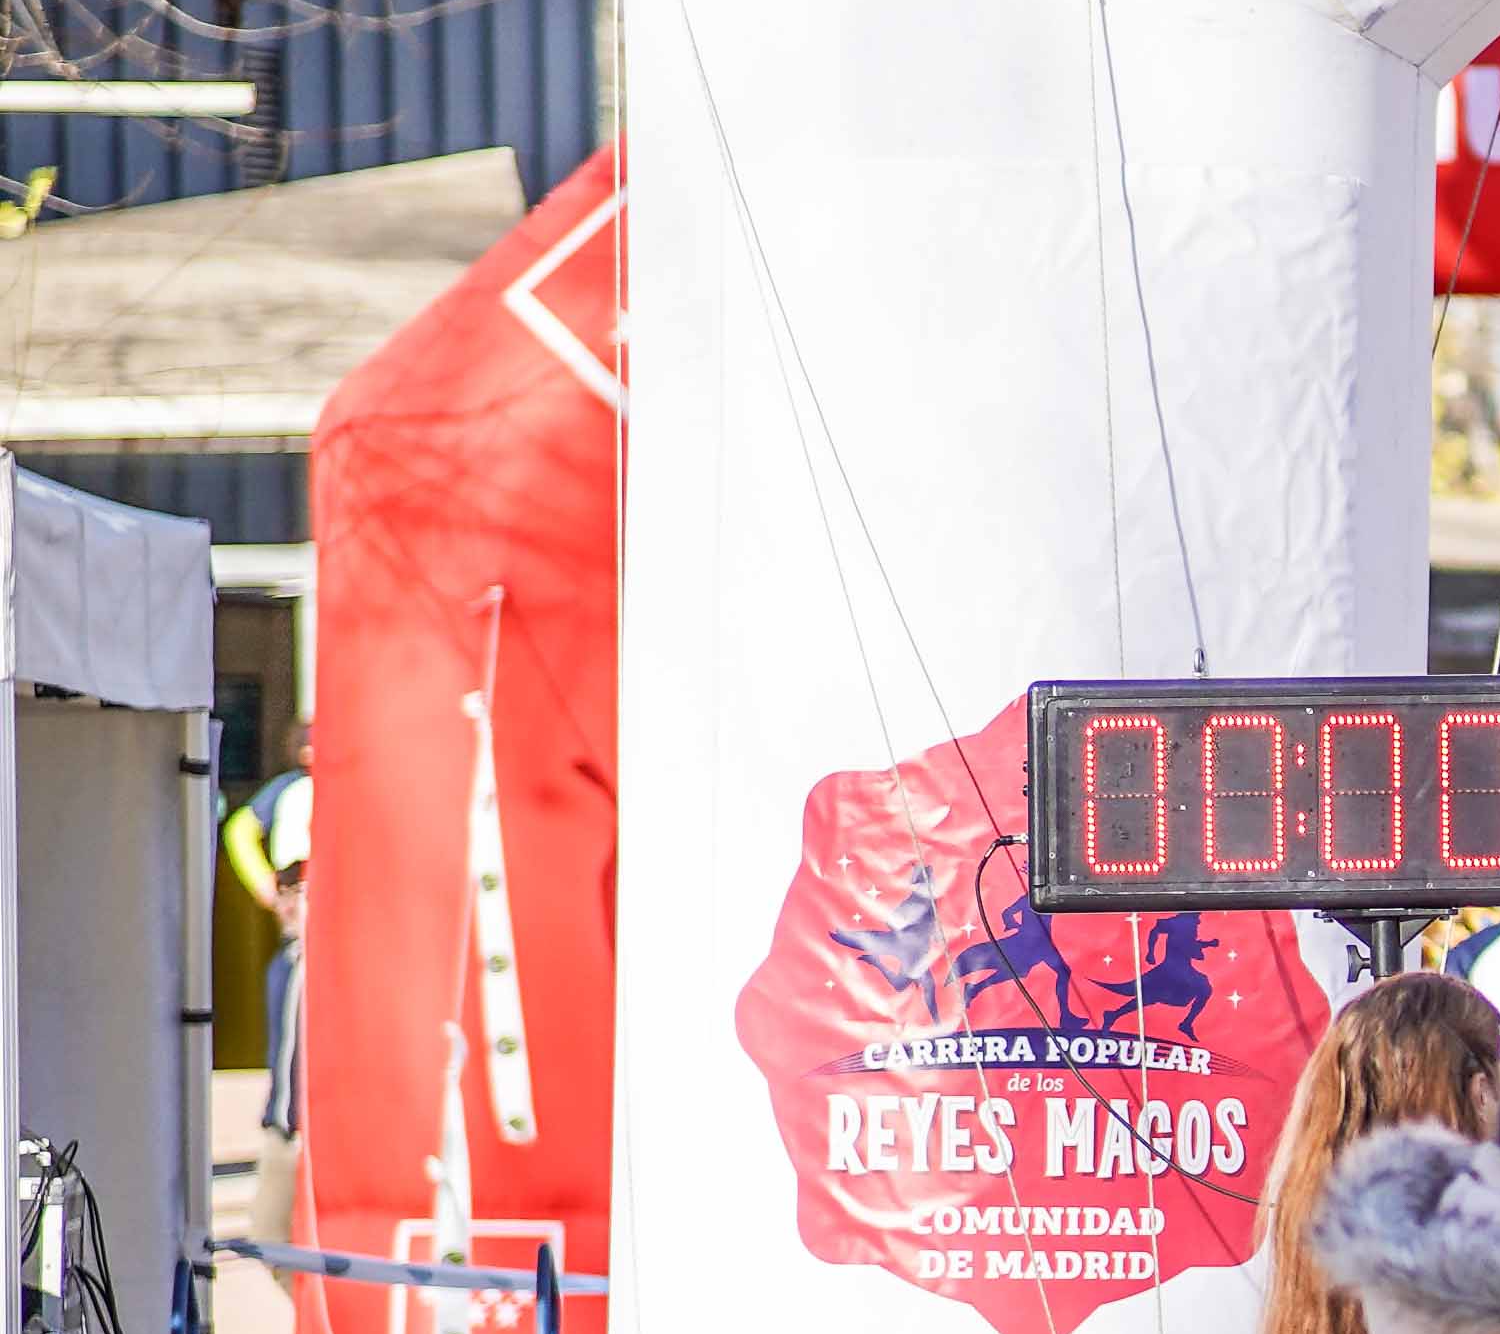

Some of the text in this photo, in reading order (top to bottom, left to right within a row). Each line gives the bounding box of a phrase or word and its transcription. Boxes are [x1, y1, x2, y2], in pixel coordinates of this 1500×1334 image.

[864, 1035, 1212, 1075] CARRERA POPULAR
[1007, 1073, 1064, 1092] de los
[827, 1093, 1249, 1179] REYES MAGOS
[911, 1206, 1165, 1237] COMUNIDAD
[918, 1250, 1156, 1281] DE MADRID
